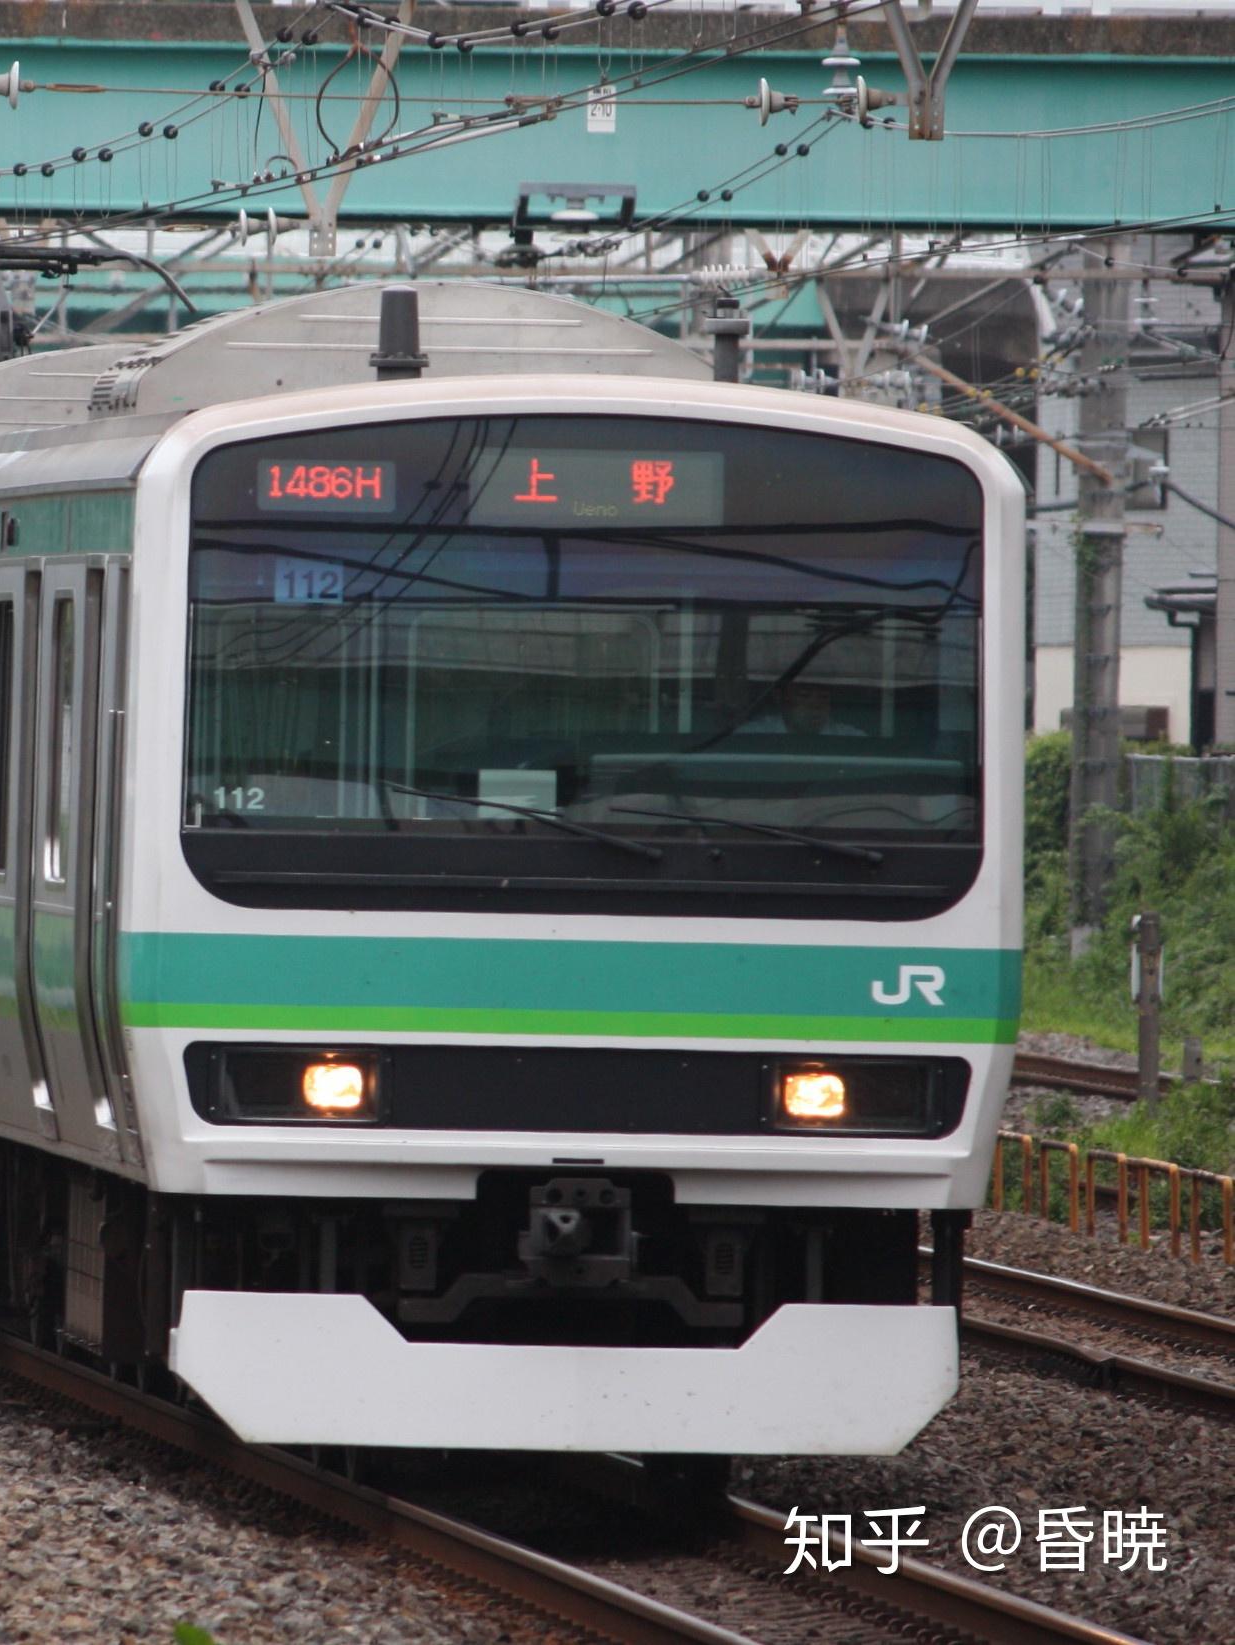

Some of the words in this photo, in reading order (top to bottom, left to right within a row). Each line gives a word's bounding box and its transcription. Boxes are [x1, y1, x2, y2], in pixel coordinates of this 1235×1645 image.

[268, 465, 381, 499] 1486H
[573, 501, 618, 517] Ueno
[283, 569, 339, 600] 112
[214, 786, 265, 810] 112
[871, 964, 946, 1006] JR
